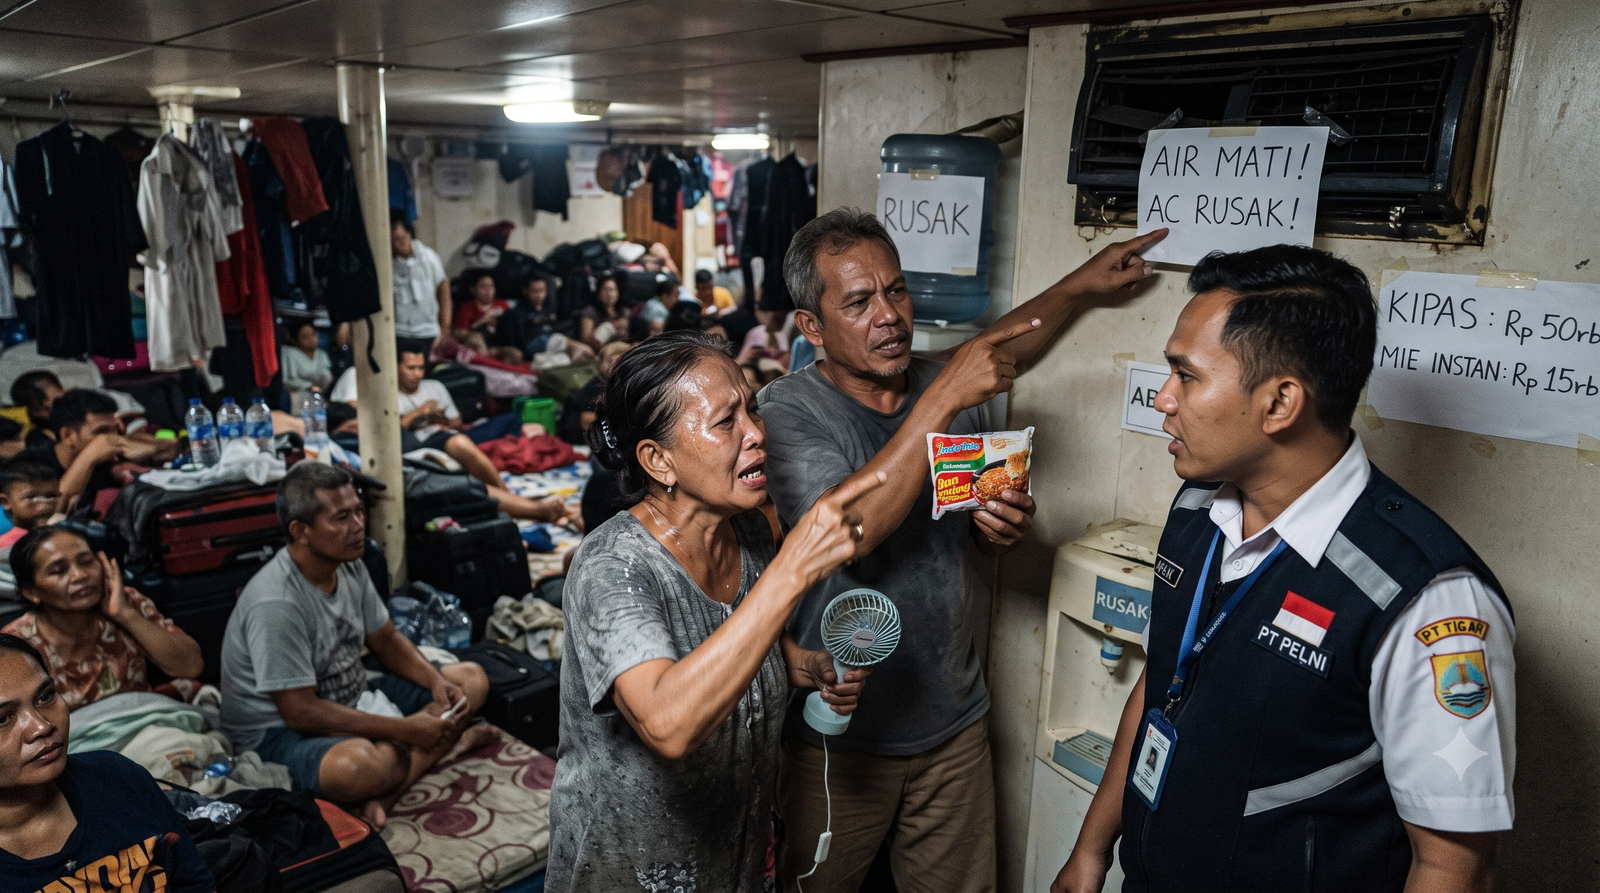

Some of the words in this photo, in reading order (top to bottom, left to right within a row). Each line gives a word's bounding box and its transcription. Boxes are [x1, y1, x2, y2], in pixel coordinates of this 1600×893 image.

[1149, 144, 1200, 177] AIR
[1215, 142, 1311, 181] MATI!
[884, 197, 970, 236] RUSAK
[1145, 194, 1180, 224] AC
[1195, 194, 1300, 231] RUSAK!
[1388, 289, 1478, 330] KIPAS
[1504, 309, 1533, 346] Rp
[1540, 313, 1600, 345] 50rb
[1379, 344, 1421, 371] MIE
[1431, 351, 1508, 382] INSTAN:
[1511, 361, 1538, 396] Rp
[1543, 365, 1599, 397] 15rb
[1096, 591, 1149, 620] RUSAK
[1257, 625, 1280, 646] PT
[1278, 636, 1328, 672] PELNI
[1421, 625, 1440, 641] PT
[1443, 620, 1484, 636] TIGAR
